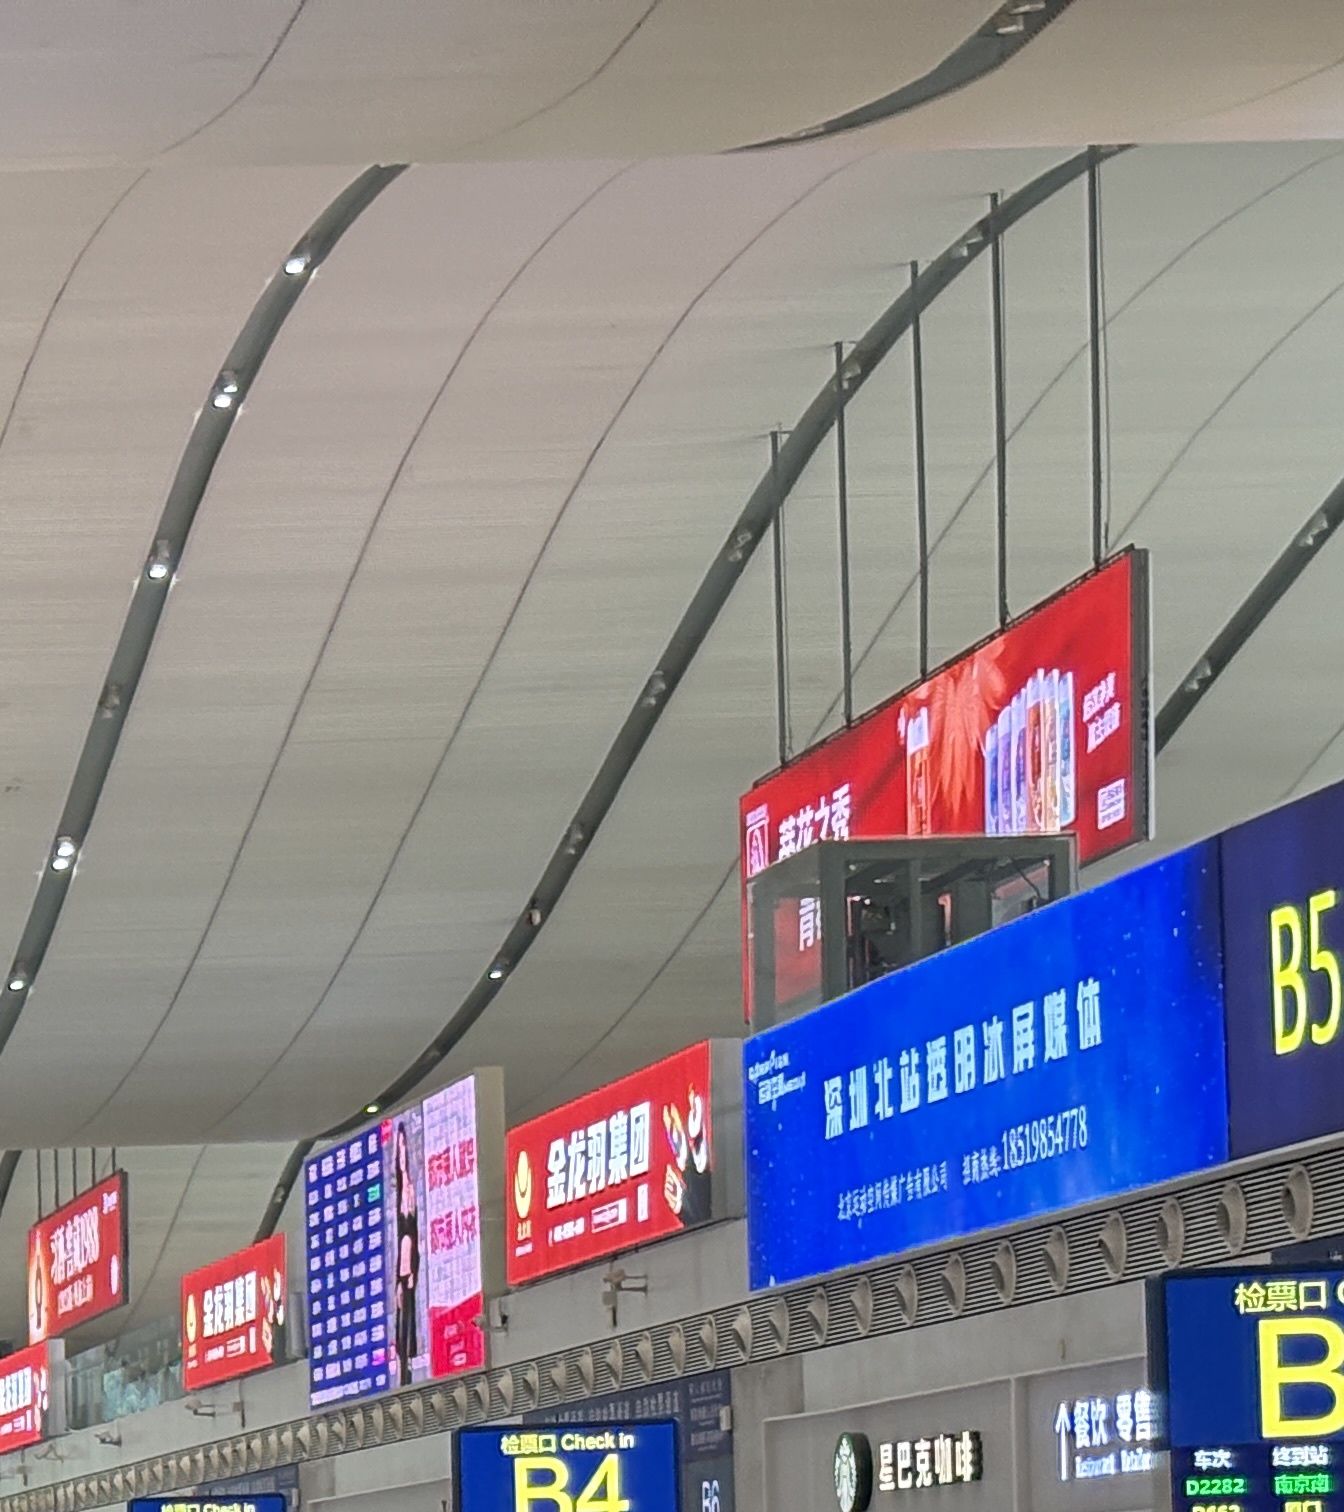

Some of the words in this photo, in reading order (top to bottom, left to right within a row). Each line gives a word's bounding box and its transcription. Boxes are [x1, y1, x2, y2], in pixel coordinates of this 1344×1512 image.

[1270, 889, 1342, 1055] B5
[824, 977, 1102, 1140] 深圳北站透明冰屏媒体
[546, 1101, 650, 1210] 金龙羽集团
[1235, 1280, 1328, 1315] 检票口
[501, 1434, 556, 1455] 检票口
[561, 1433, 615, 1451] Check
[619, 1432, 634, 1449] in
[1073, 1397, 1109, 1449] 餐饮
[1116, 1389, 1152, 1443] 零售
[878, 1430, 973, 1491] 星巴克咖啡
[1185, 1478, 1245, 1496] D2282
[1274, 1474, 1330, 1495] 南京南
[1194, 1450, 1233, 1470] 车次
[1273, 1446, 1329, 1466] 终到站
